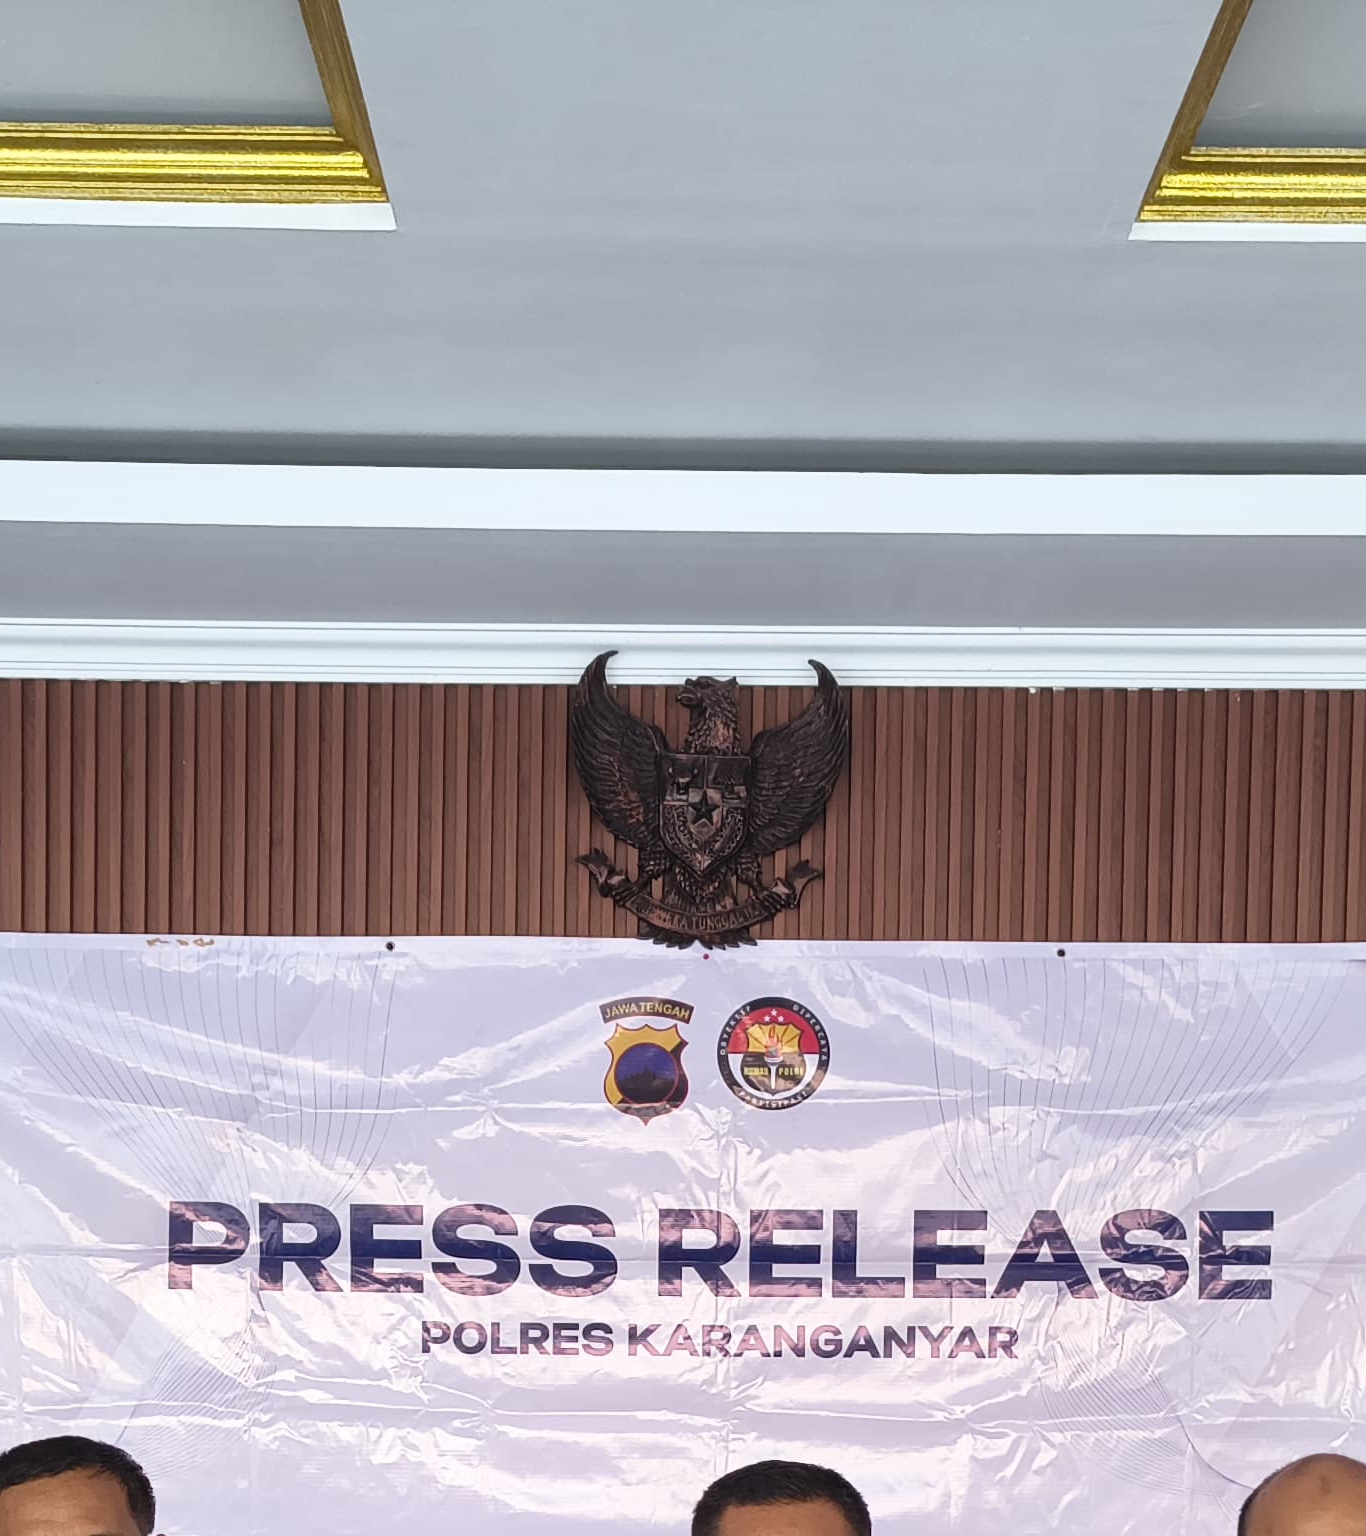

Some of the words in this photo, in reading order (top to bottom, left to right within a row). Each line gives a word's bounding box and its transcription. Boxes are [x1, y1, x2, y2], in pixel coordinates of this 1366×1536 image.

[605, 1002, 636, 1019] JAWA
[639, 1001, 691, 1019] TENGAH
[168, 1201, 618, 1297] PRESS
[658, 1207, 1274, 1301] RELEASE
[422, 1320, 613, 1357] POLRES
[628, 1323, 1019, 1360] KARANGANYAR
